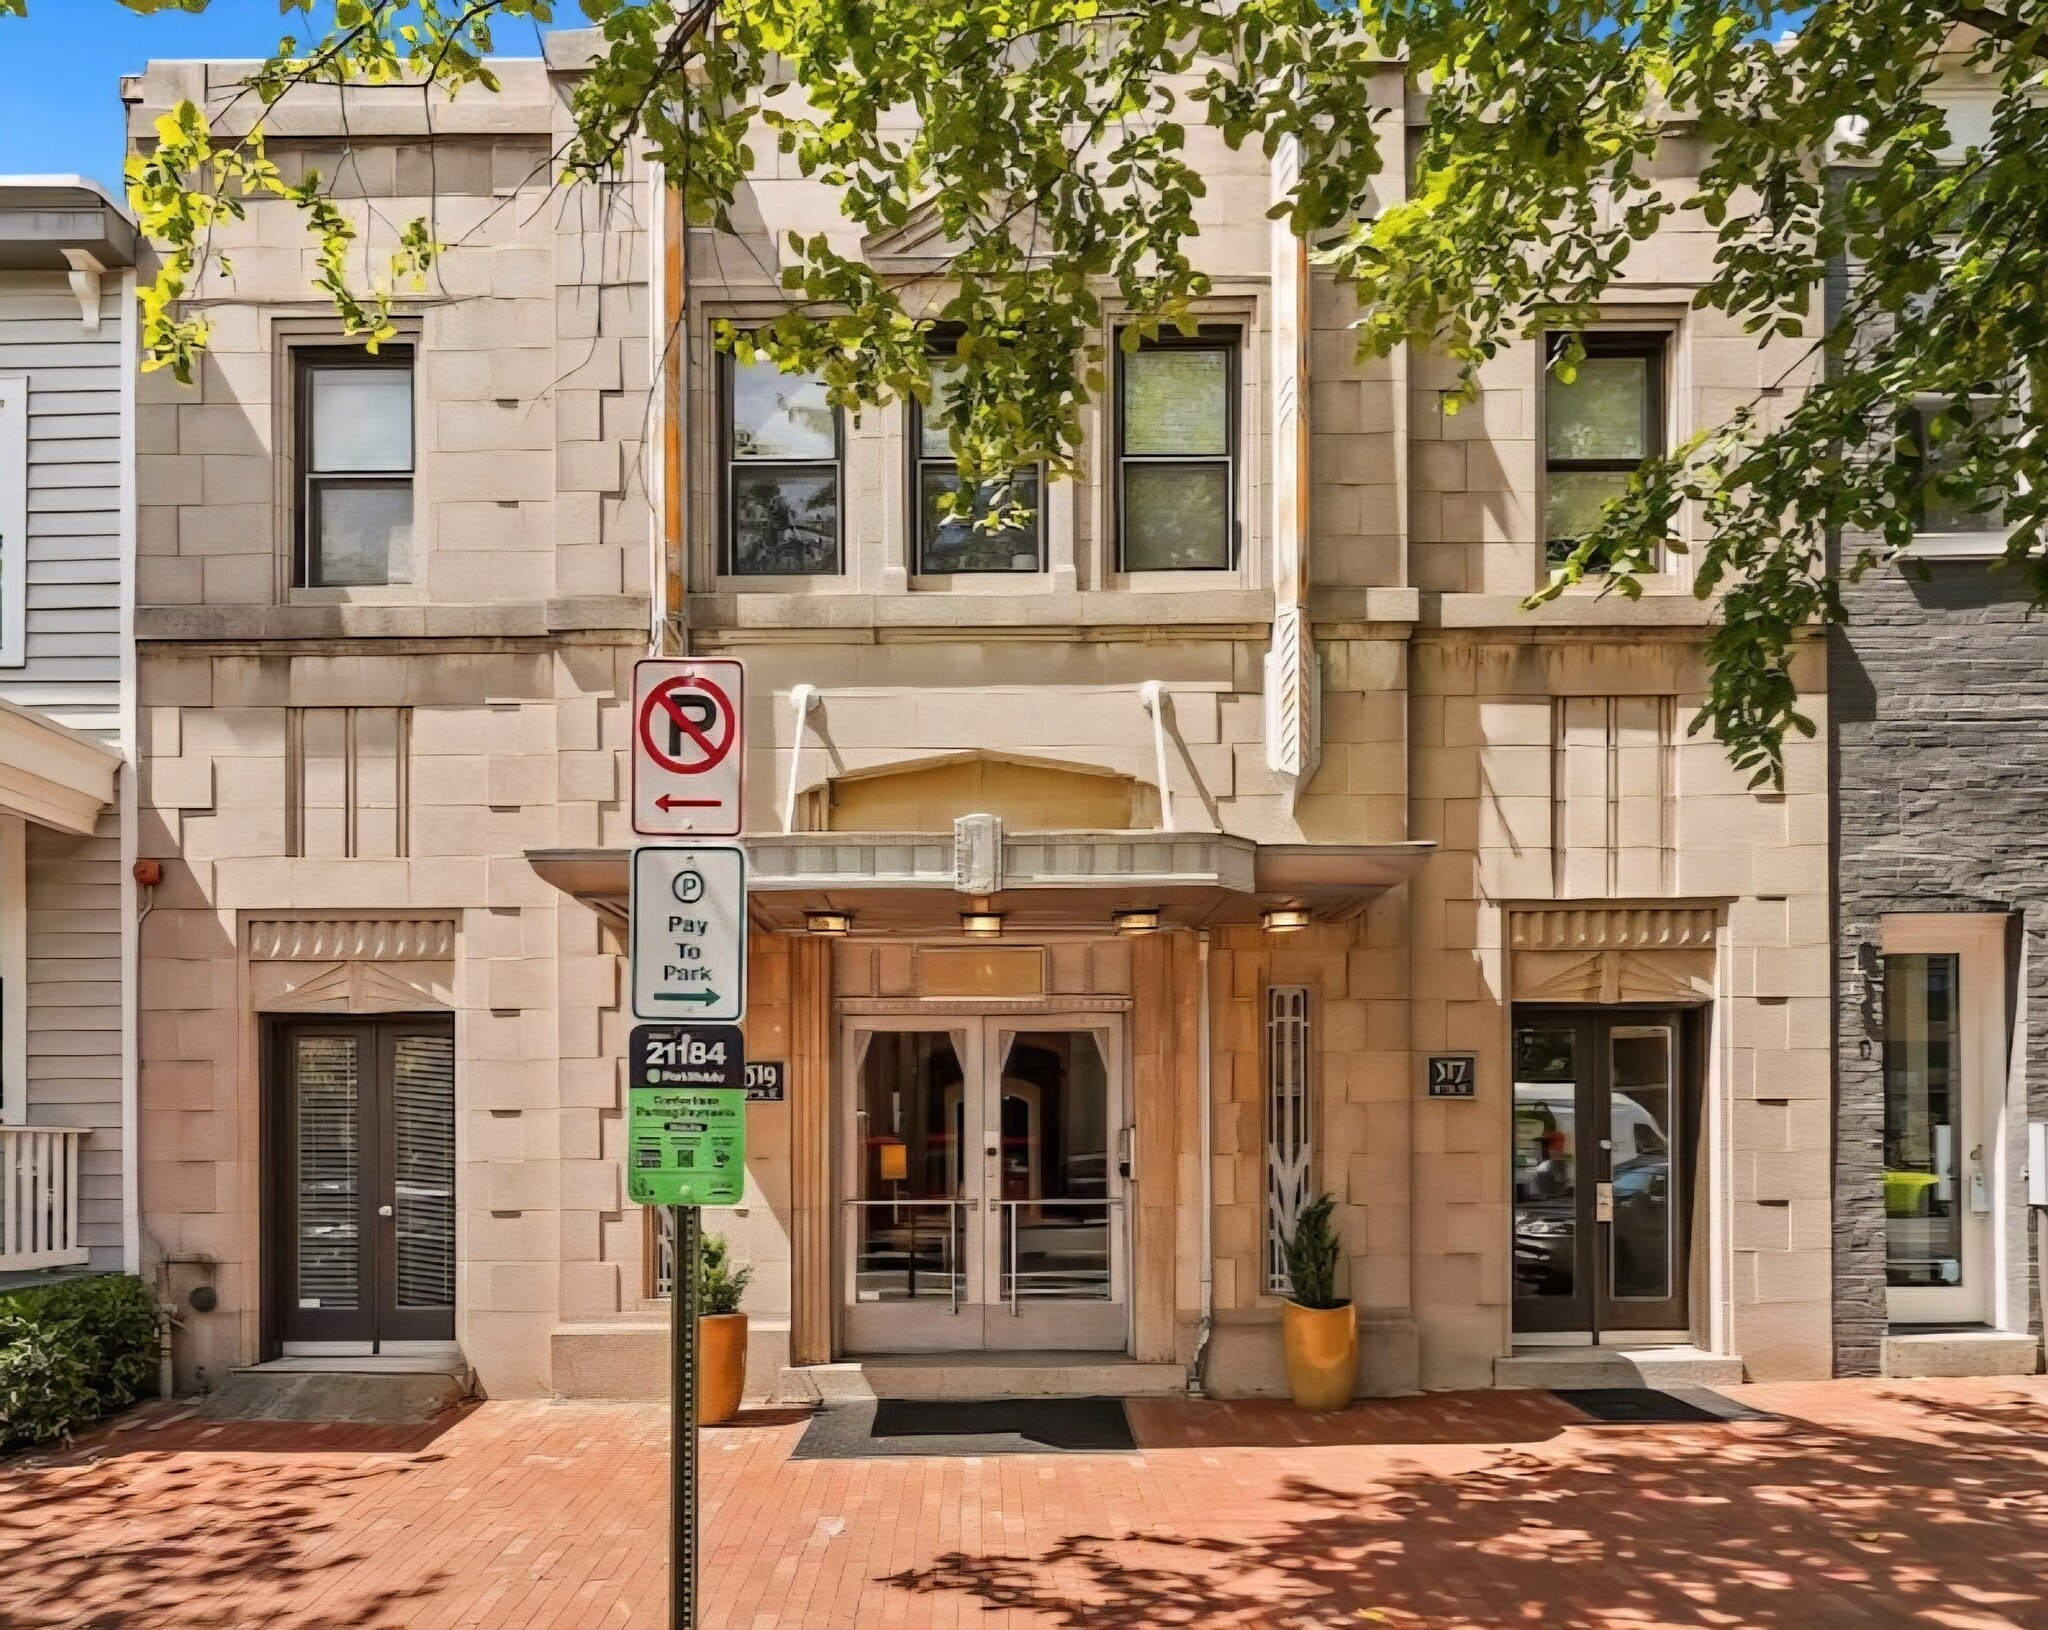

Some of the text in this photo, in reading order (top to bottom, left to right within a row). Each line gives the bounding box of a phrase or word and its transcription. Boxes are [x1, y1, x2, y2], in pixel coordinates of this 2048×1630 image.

[669, 694, 717, 757] P
[683, 878, 697, 897] P
[668, 915, 709, 936] Pay
[675, 943, 701, 960] To
[664, 965, 712, 981] Park
[646, 1041, 727, 1065] 21184
